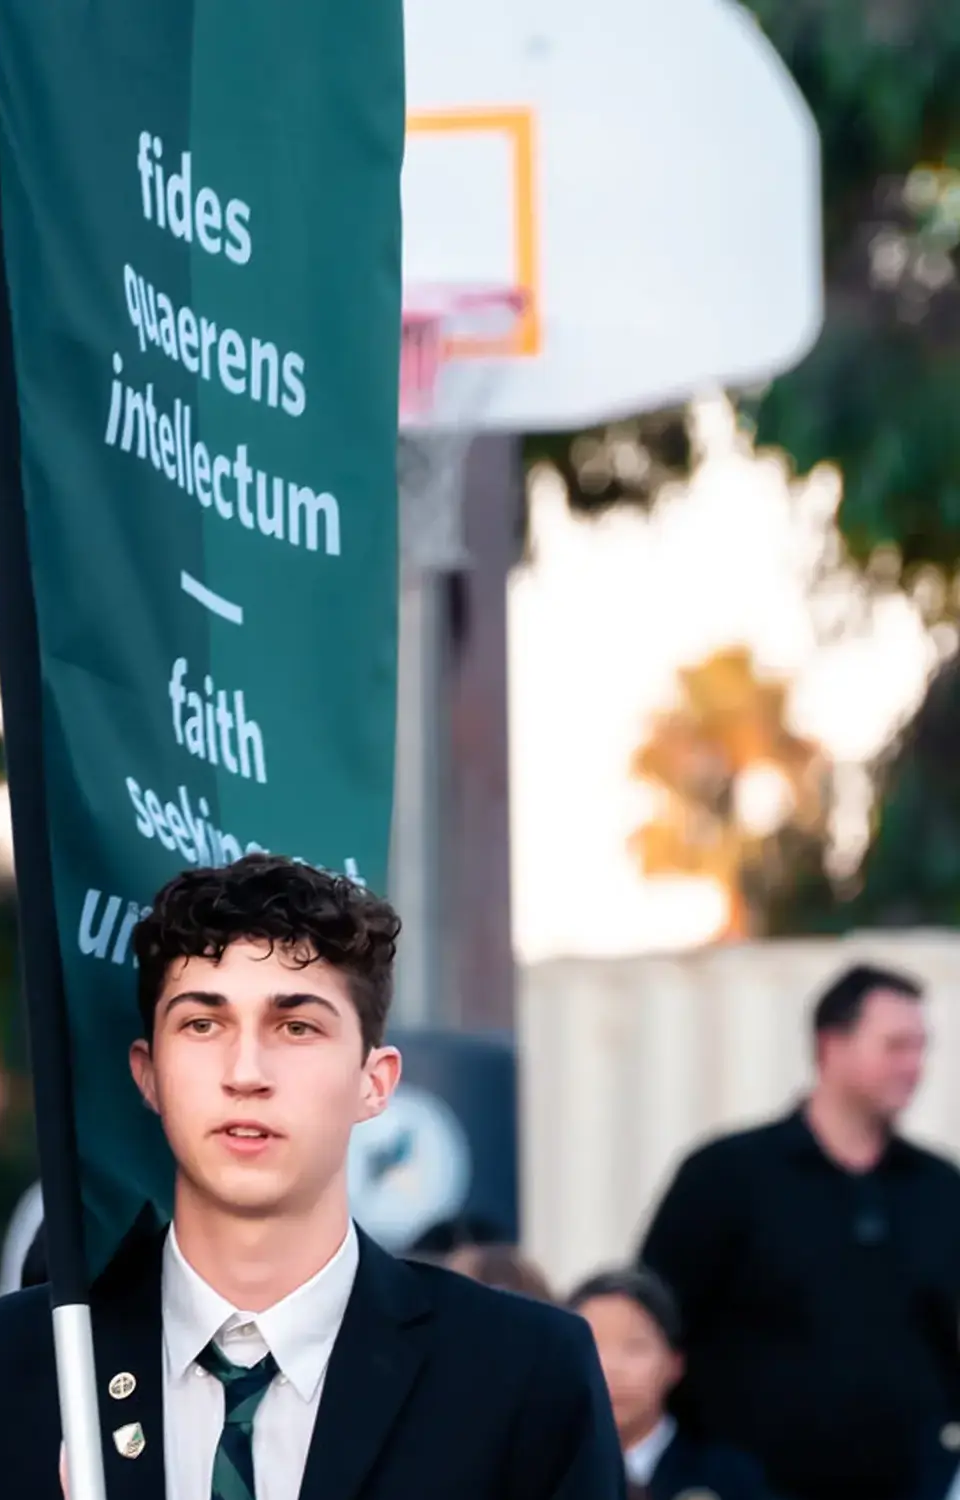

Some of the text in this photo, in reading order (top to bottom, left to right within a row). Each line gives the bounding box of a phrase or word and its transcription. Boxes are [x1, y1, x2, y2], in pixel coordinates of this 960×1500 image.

[137, 131, 252, 264] fides
[124, 263, 306, 417] quaerens
[105, 352, 341, 556] intellectum
[168, 657, 268, 784] faith
